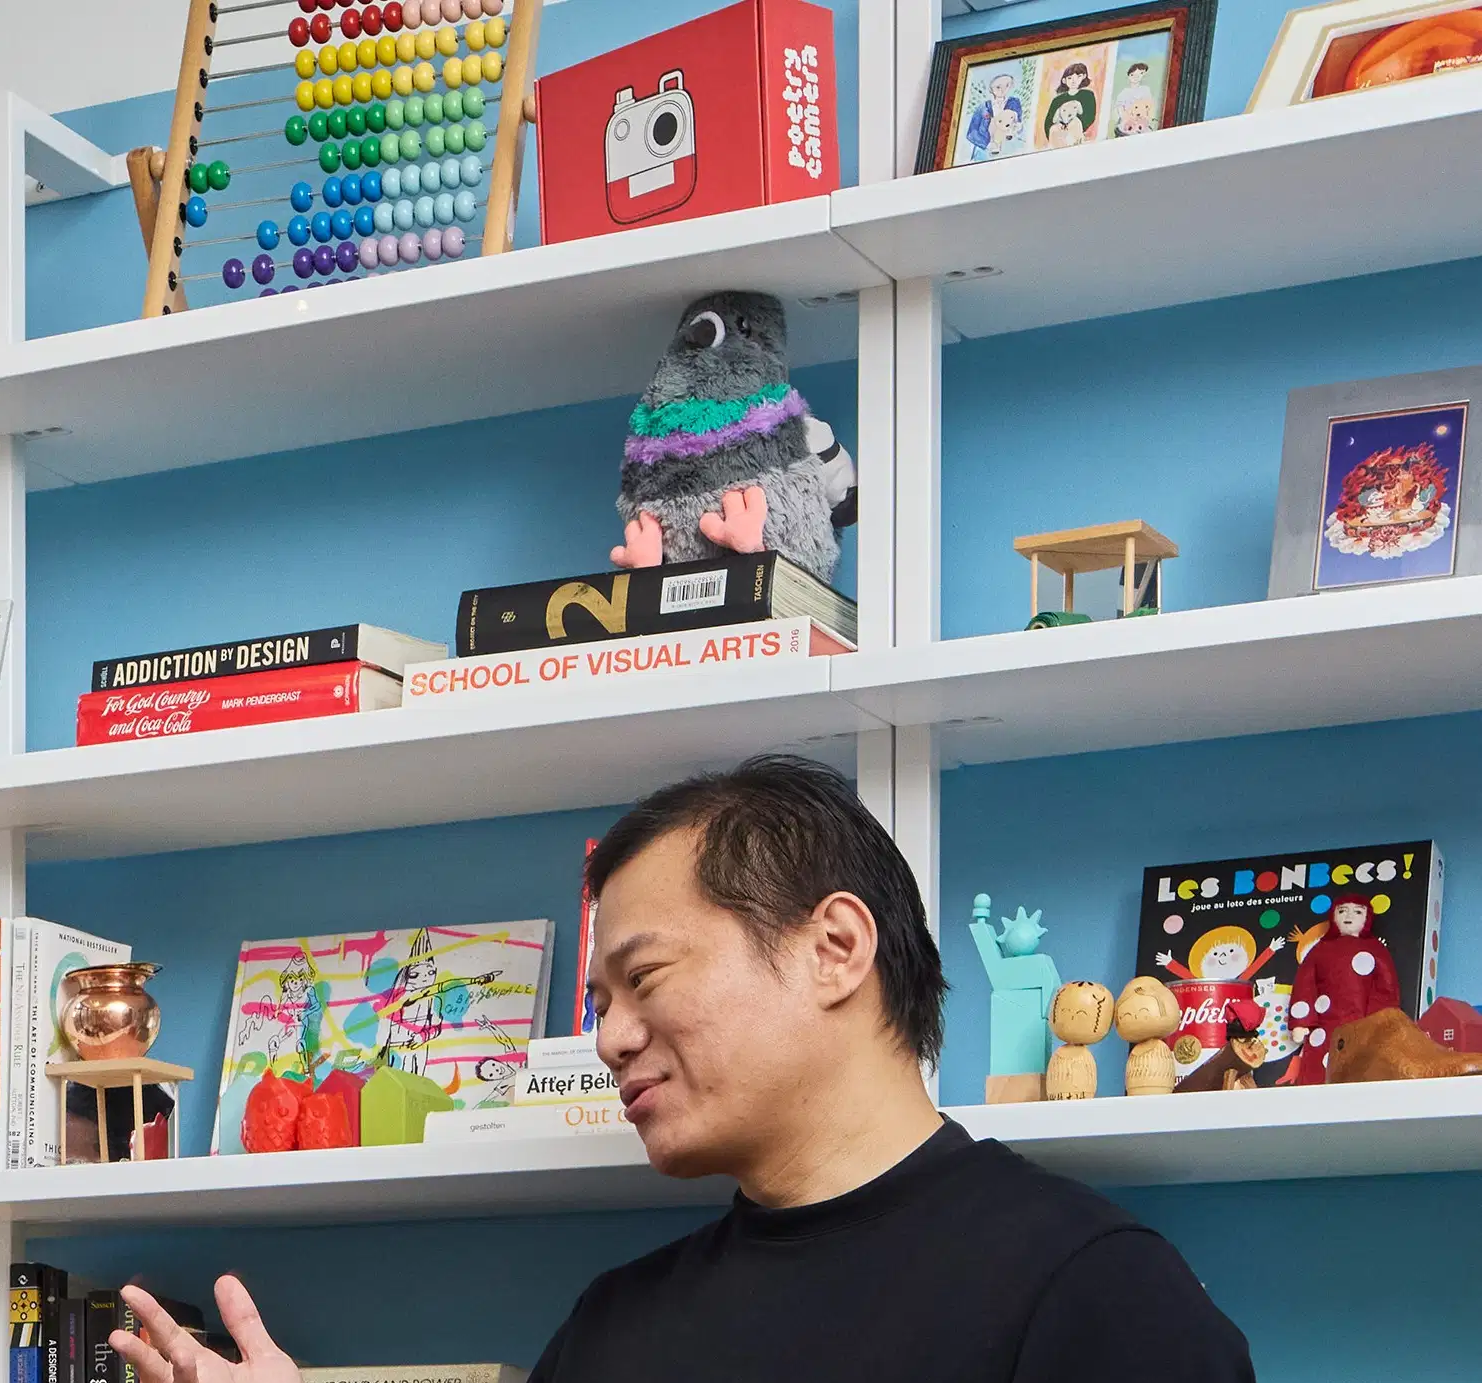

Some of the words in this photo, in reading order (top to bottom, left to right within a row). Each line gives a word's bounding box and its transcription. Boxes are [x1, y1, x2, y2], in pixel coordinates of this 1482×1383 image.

[783, 48, 805, 168] poetry
[801, 45, 822, 179] camera
[754, 564, 764, 602] TASCHEN
[790, 628, 799, 653] 2016
[113, 650, 217, 686] ADDICTION
[221, 648, 234, 662] BY
[236, 636, 310, 669] DESIGN
[410, 662, 530, 696] SCHOOL
[540, 655, 578, 681] OF
[586, 642, 691, 675] VISUAL
[699, 631, 781, 663] ARTS
[101, 696, 124, 717] For
[154, 690, 211, 712] Country
[221, 697, 244, 709] MARK
[245, 691, 301, 708] PENDERGRAST
[109, 718, 133, 736] and
[1190, 901, 1211, 913] joue
[1213, 901, 1225, 910] au
[1226, 899, 1244, 909] loto
[1247, 896, 1262, 907] des
[1265, 894, 1303, 904] couleurs
[58, 932, 85, 947] NATIONAL
[86, 940, 118, 954] BESTSELLER
[15, 963, 25, 983] THE
[13, 1044, 24, 1068] RULE
[31, 1048, 36, 1058] OF
[565, 1105, 610, 1127] Out
[95, 1342, 113, 1373] the
